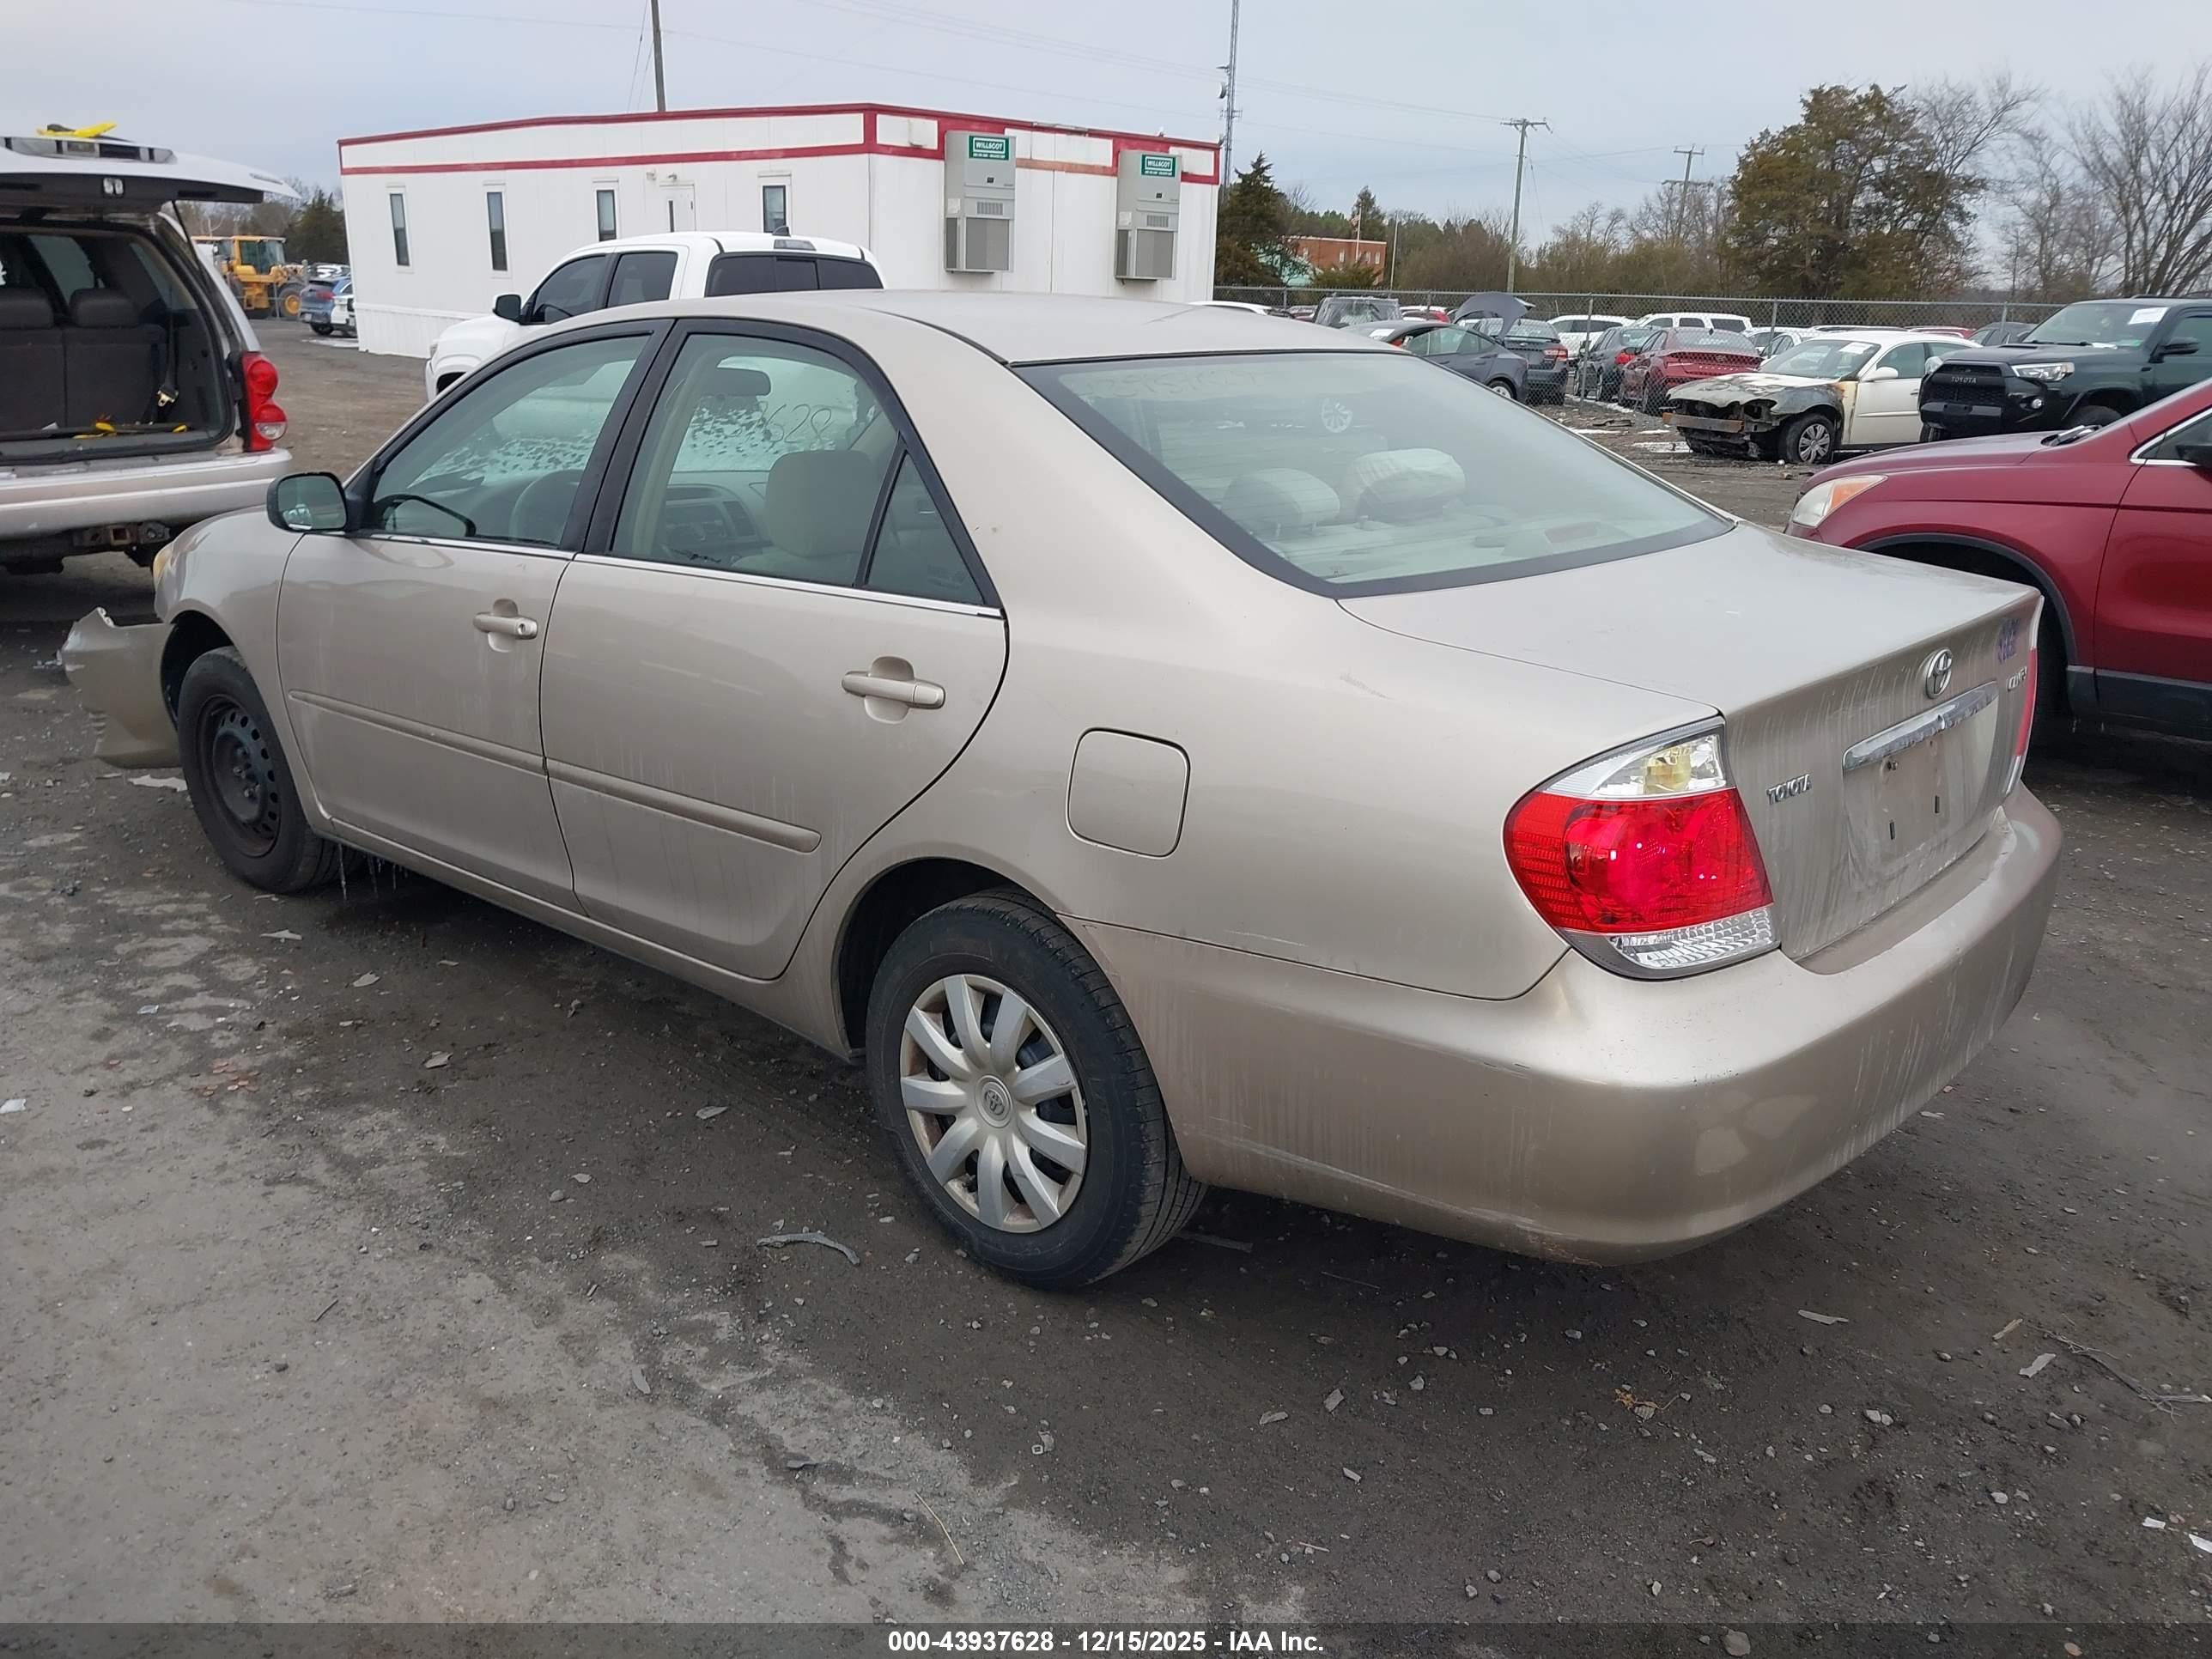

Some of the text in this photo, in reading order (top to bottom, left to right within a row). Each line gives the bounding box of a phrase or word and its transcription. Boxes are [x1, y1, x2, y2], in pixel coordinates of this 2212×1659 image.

[975, 142, 1004, 150] WILLSCOT
[1147, 160, 1170, 168] WILLSCOT
[1766, 774, 1812, 805] TOYOTA
